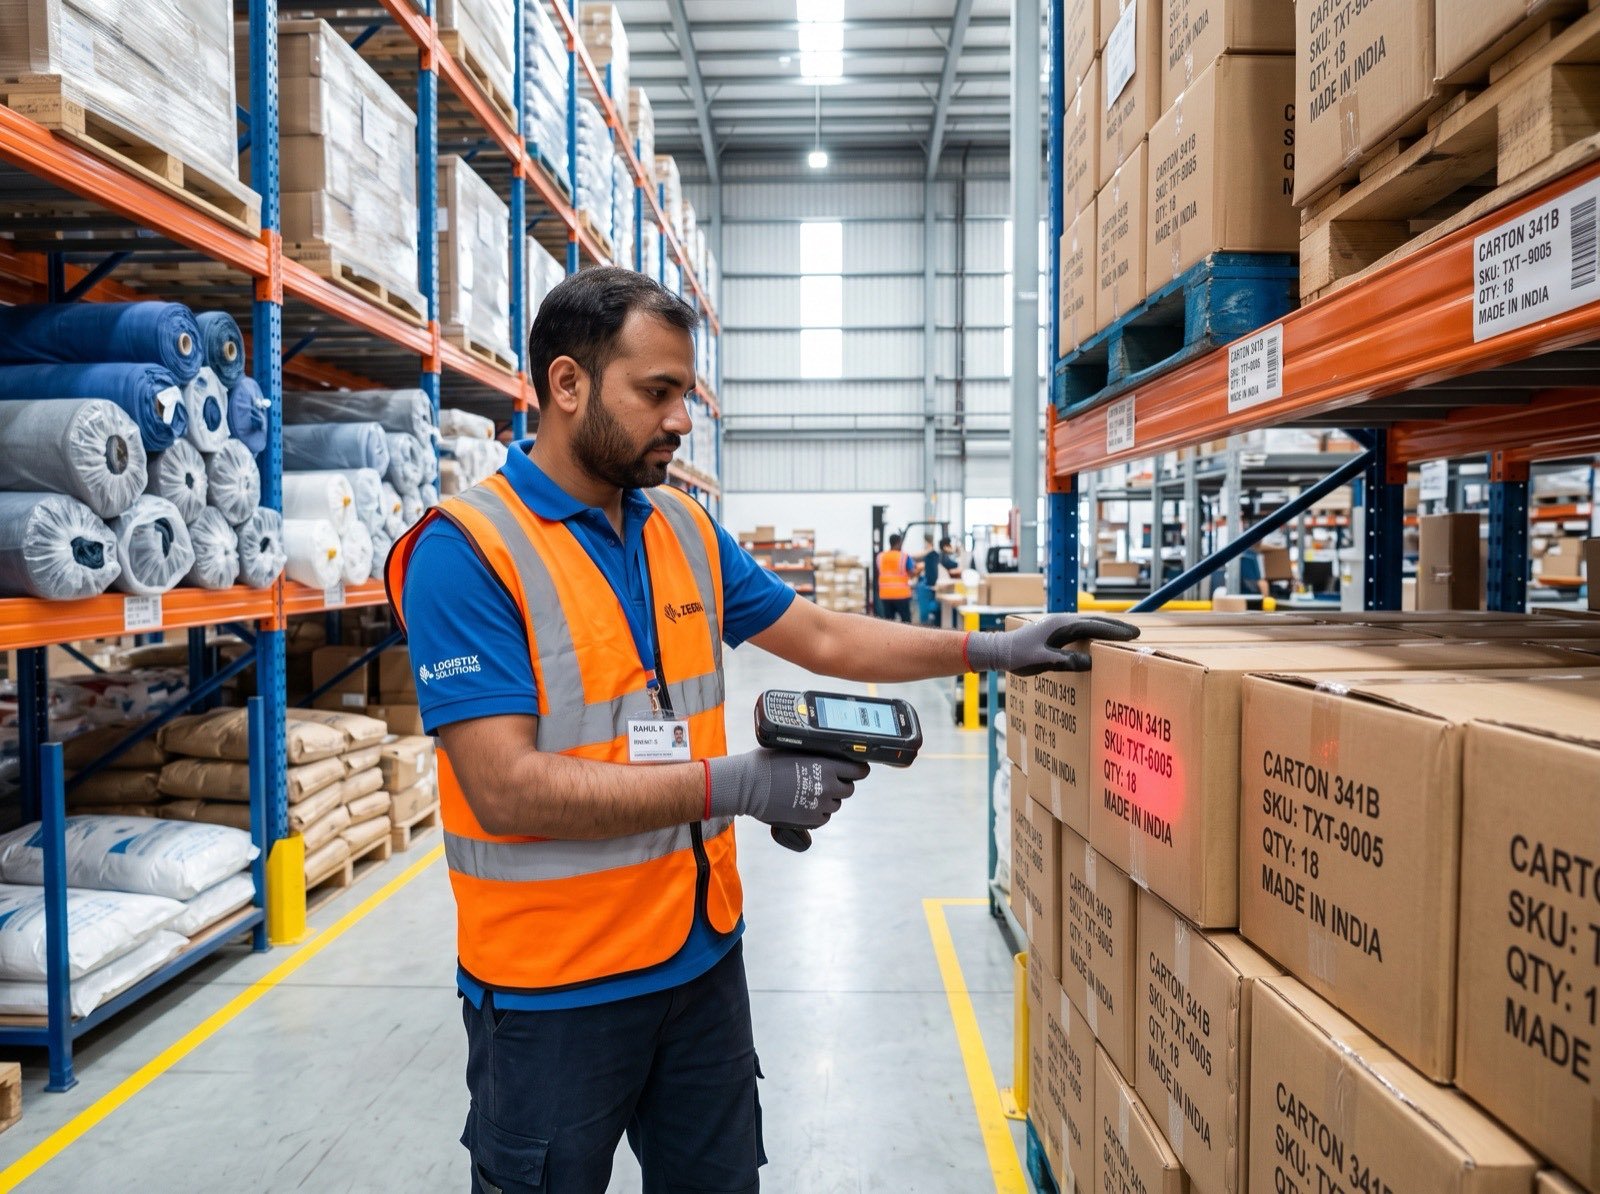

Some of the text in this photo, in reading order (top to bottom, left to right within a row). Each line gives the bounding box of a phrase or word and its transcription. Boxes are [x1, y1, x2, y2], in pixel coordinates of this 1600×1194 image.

[1310, 27, 1331, 63] SKU:
[1310, 41, 1347, 92] QTY: 18
[1310, 35, 1387, 123] MADE IN INDIA
[1156, 148, 1179, 182] CARTON
[1155, 220, 1171, 245] MADE
[1180, 200, 1197, 229] INDIA
[1479, 208, 1559, 262] CARTON 341B
[1479, 241, 1552, 285] SKU: TXT-9005
[1479, 277, 1514, 304] QTY: 18
[1479, 285, 1549, 325] MADE IN INDIA
[433, 654, 479, 673] LOGISTIX
[435, 664, 481, 681] SOLUTIONS
[1035, 675, 1076, 707] CARTON 341B
[1035, 699, 1048, 720] SKU:
[633, 725, 666, 733] RAHUL K
[1035, 723, 1056, 749] QTY: 18
[1105, 699, 1171, 743] CARTON 341B
[1035, 747, 1077, 788] MADE IN INDIA
[1104, 729, 1172, 778] SKU: TXT-6005
[1104, 759, 1137, 794] QTY: 18
[1263, 750, 1380, 820] CARTON 341B
[1104, 787, 1173, 848] MADE IN INDIA
[1262, 788, 1384, 868] SKU: TXT-9005
[1262, 827, 1320, 880] QTY: 18
[1070, 872, 1112, 929] CARTON 341B
[1262, 863, 1384, 964] MADE IN INDIA
[1508, 889, 1577, 955] SKU:
[1085, 939, 1091, 960] 18
[1070, 945, 1114, 1016] MADE IN INDIA
[1149, 951, 1210, 1038] CARTON 341B
[1506, 944, 1571, 1012] QTY:
[1149, 982, 1212, 1076] SKU: TXT-0005
[1149, 1014, 1180, 1069] QTY: 18
[1505, 996, 1591, 1086] MADE
[1149, 1044, 1211, 1151] MADE IN INDIA
[1104, 1115, 1130, 1178] CARTON
[1276, 1081, 1344, 1175] CARTON
[1276, 1123, 1311, 1186] SKU:
